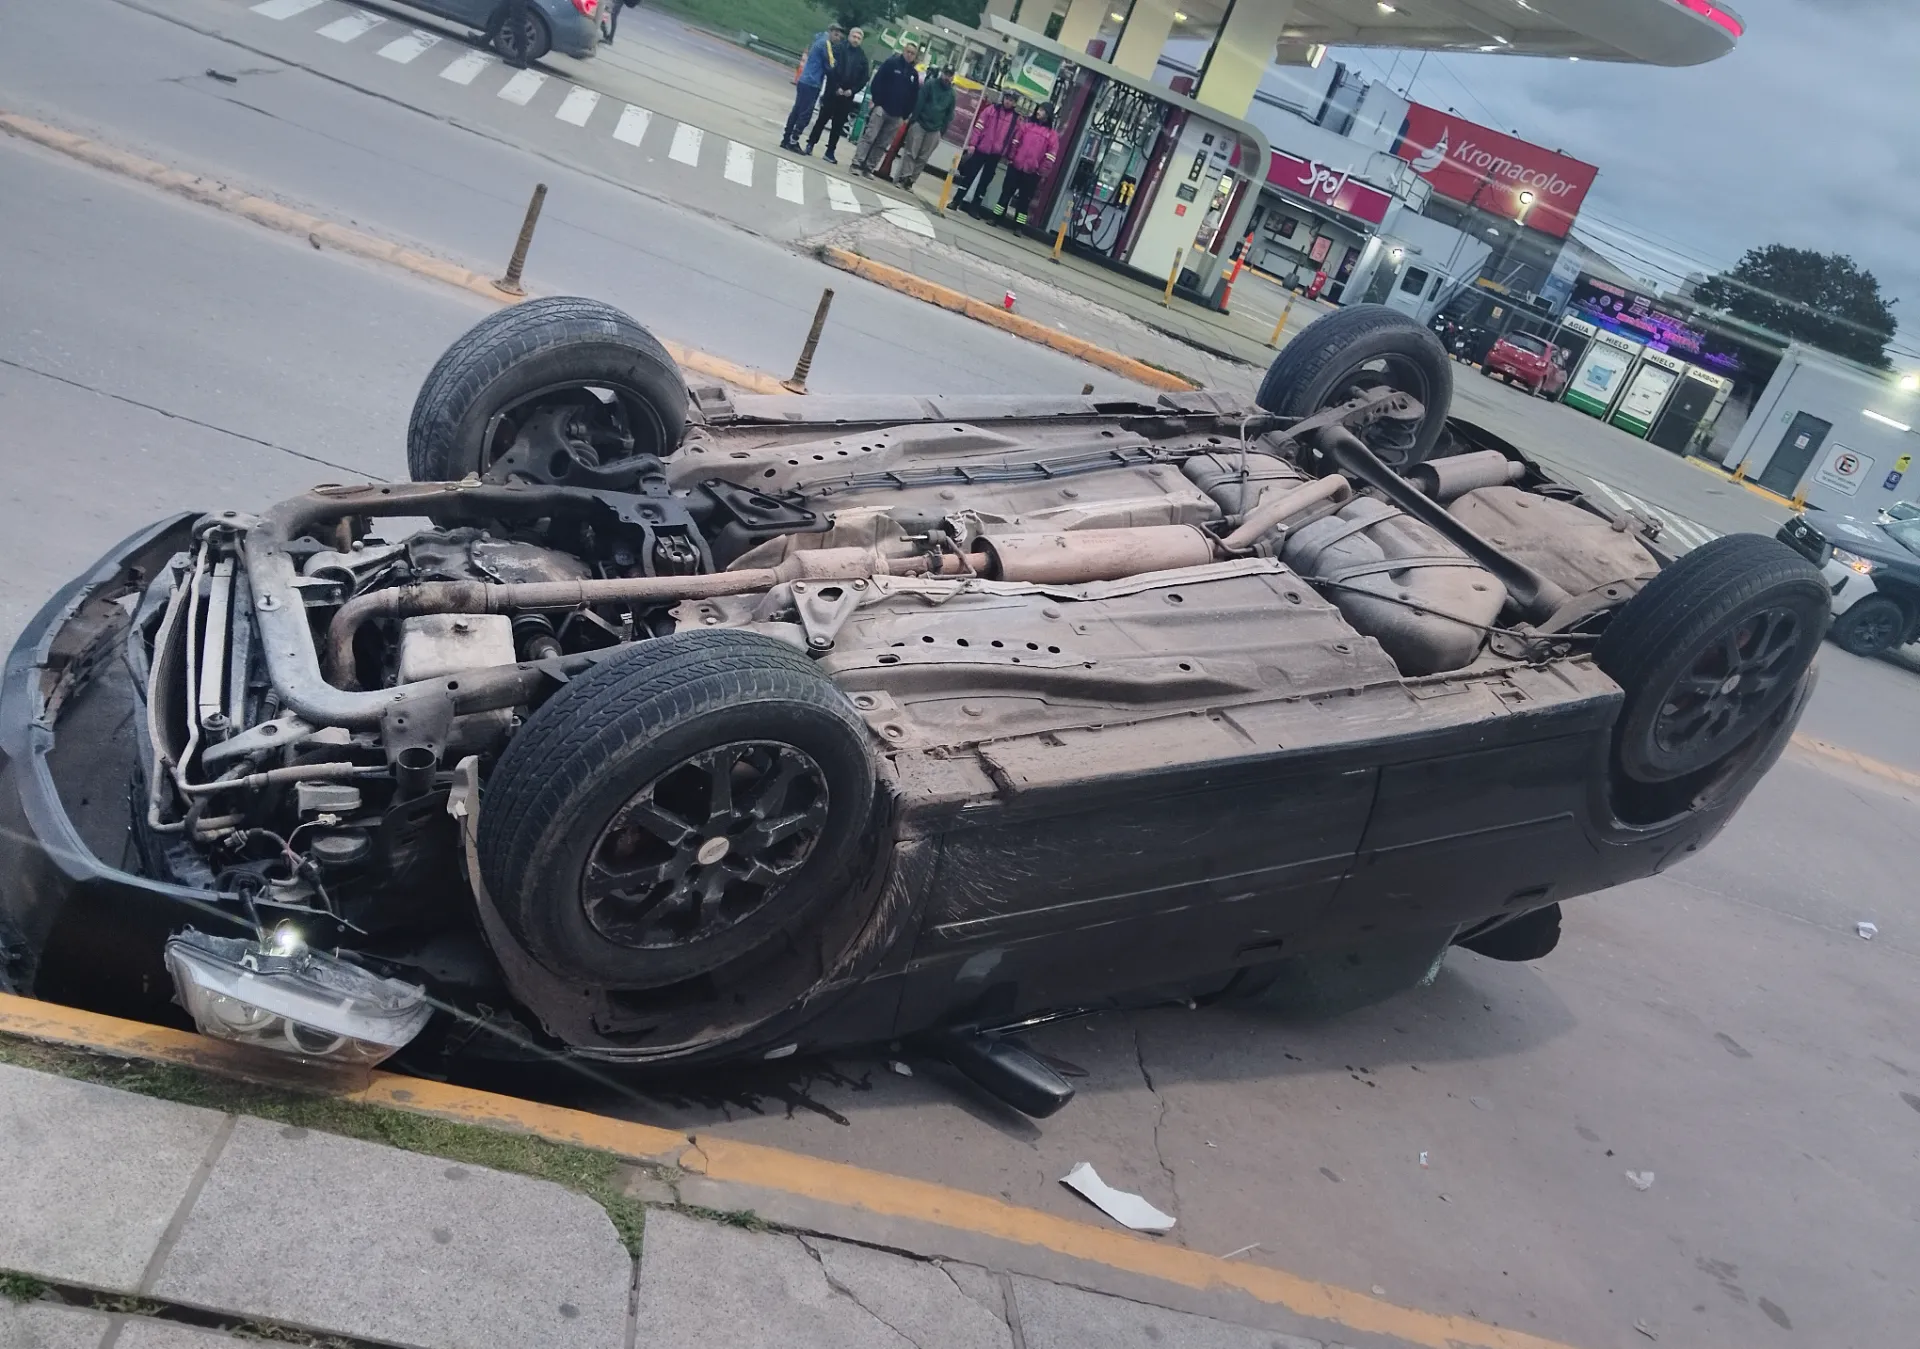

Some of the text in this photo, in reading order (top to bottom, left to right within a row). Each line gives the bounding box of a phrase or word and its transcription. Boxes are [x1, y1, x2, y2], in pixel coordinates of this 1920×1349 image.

[1453, 140, 1577, 198] Kromacolor
[1568, 320, 1589, 334] AGUA
[1605, 336, 1629, 350] HIELO
[1651, 354, 1676, 369] HIELO
